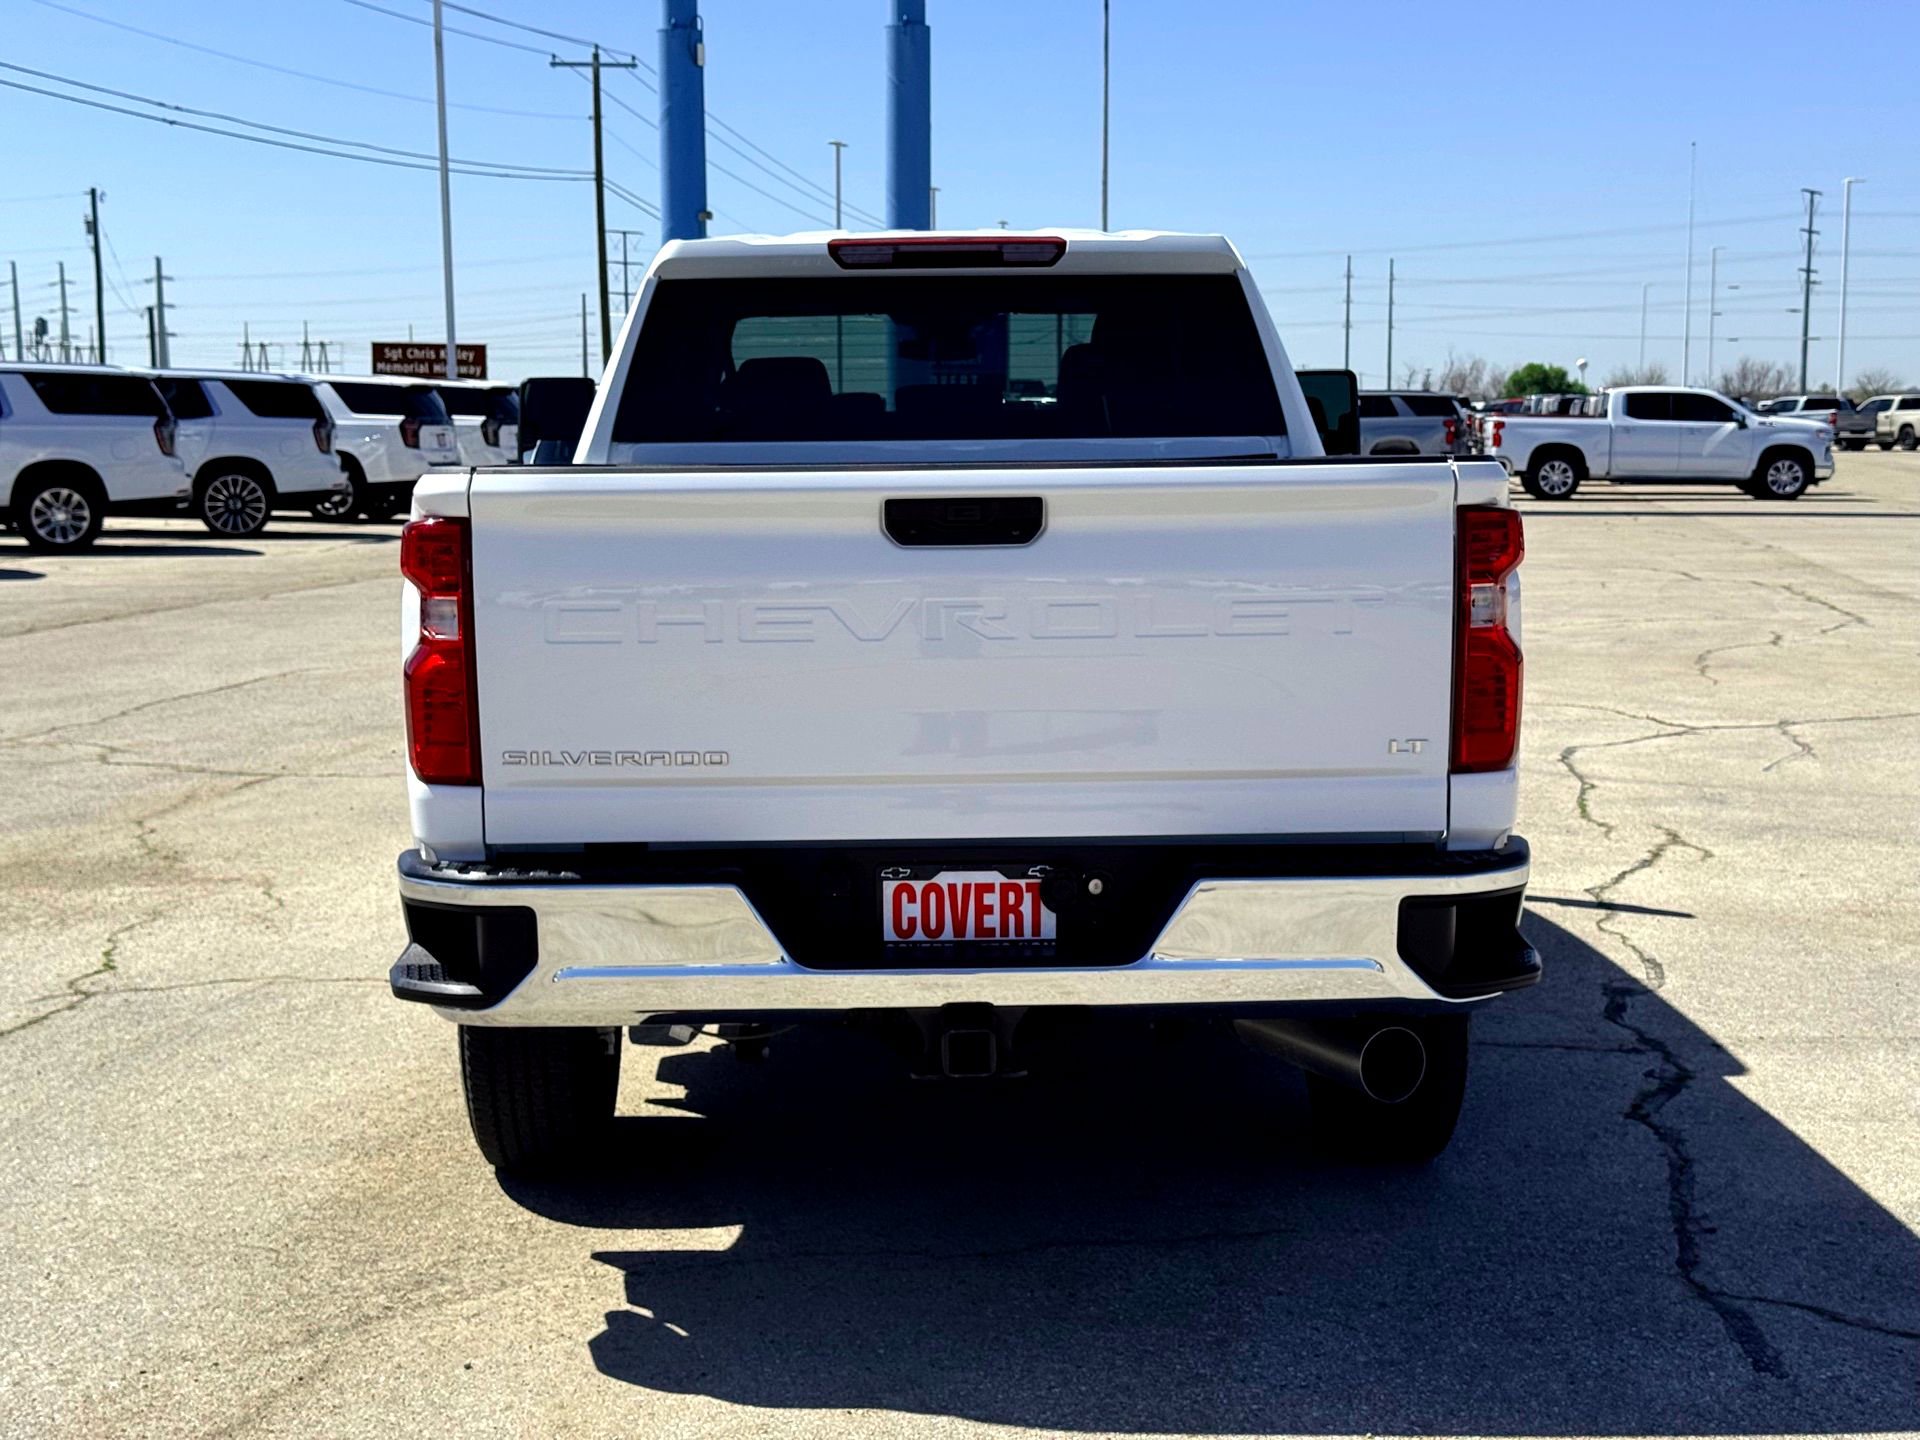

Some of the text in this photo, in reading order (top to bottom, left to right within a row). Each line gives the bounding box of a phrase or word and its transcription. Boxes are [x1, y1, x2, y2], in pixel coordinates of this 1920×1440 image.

[384, 347, 475, 363] Sgt Chris Kley
[376, 361, 482, 377] Memorial Hiway
[544, 592, 1387, 644] CHEVROLET
[1388, 738, 1429, 753] LT
[502, 751, 729, 766] SILVERADO
[892, 882, 1042, 939] COVERT
